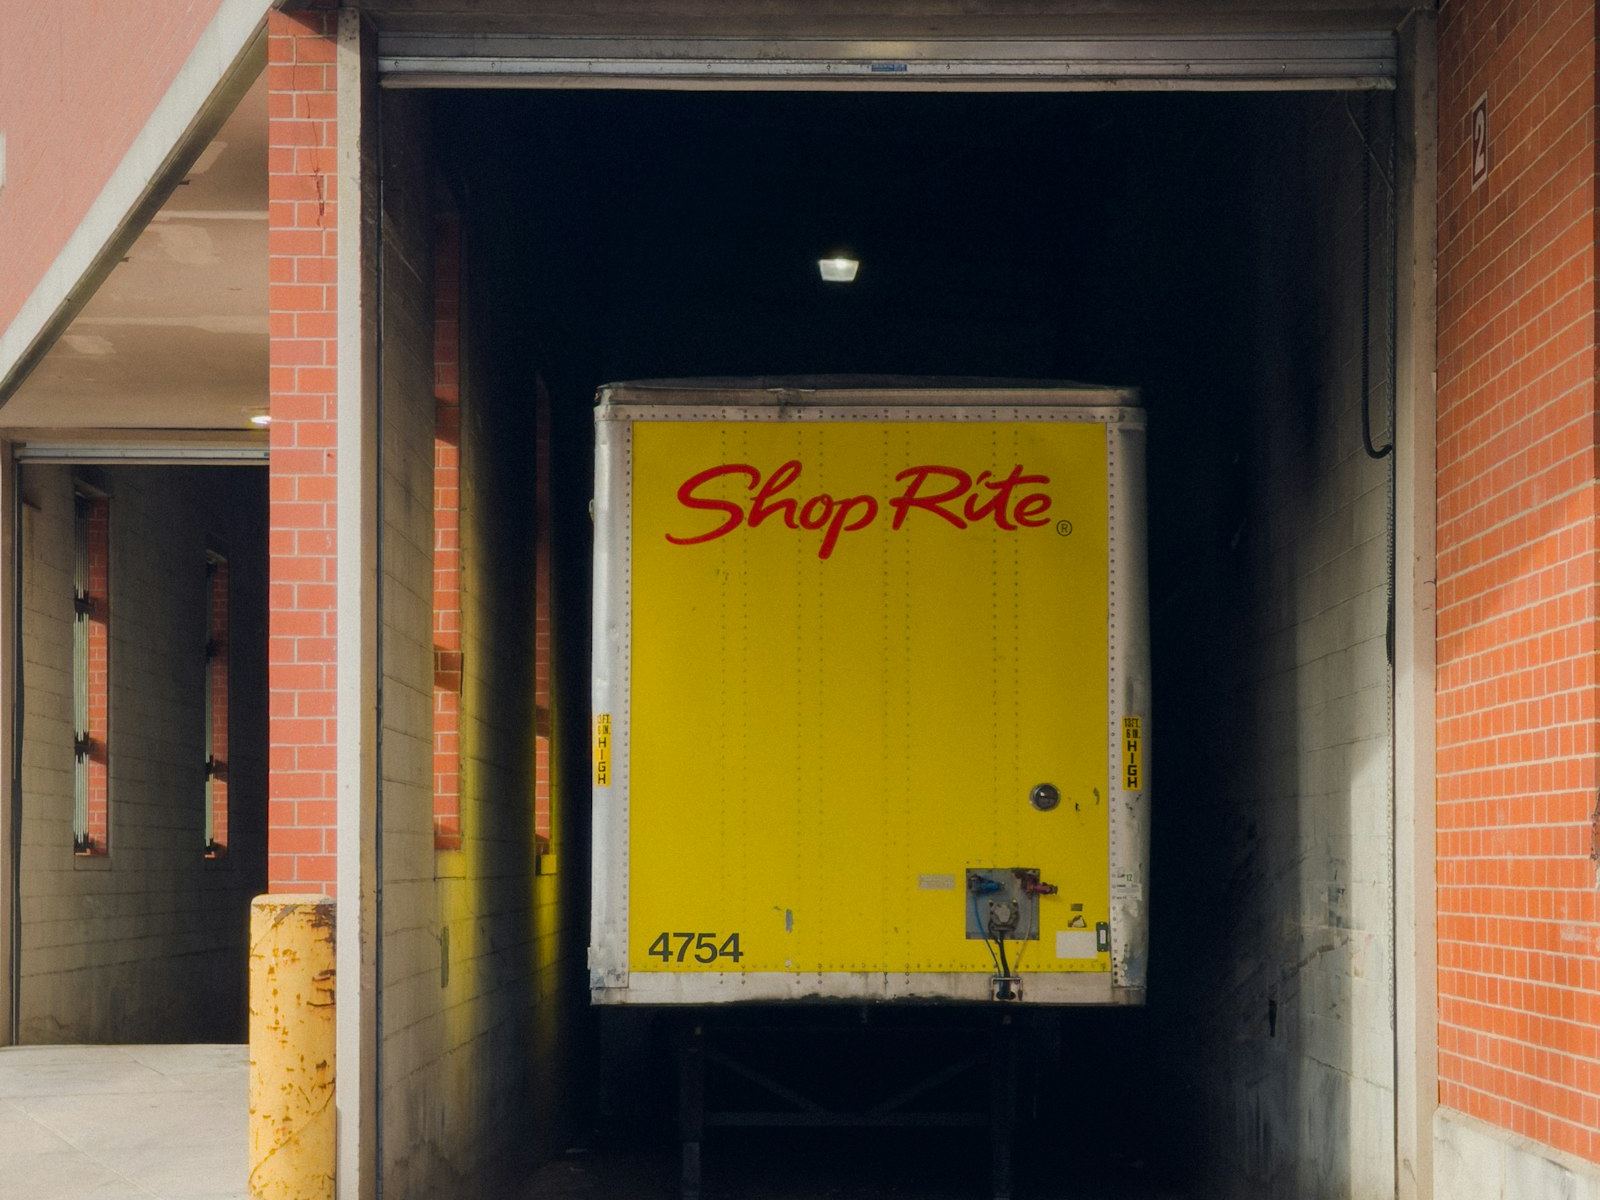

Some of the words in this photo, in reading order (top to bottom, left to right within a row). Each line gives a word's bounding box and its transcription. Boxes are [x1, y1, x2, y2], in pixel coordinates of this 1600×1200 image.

[1474, 109, 1485, 177] 2
[597, 737, 607, 784] HIGH
[1127, 740, 1138, 788] HIGH
[648, 932, 744, 964] 4754
